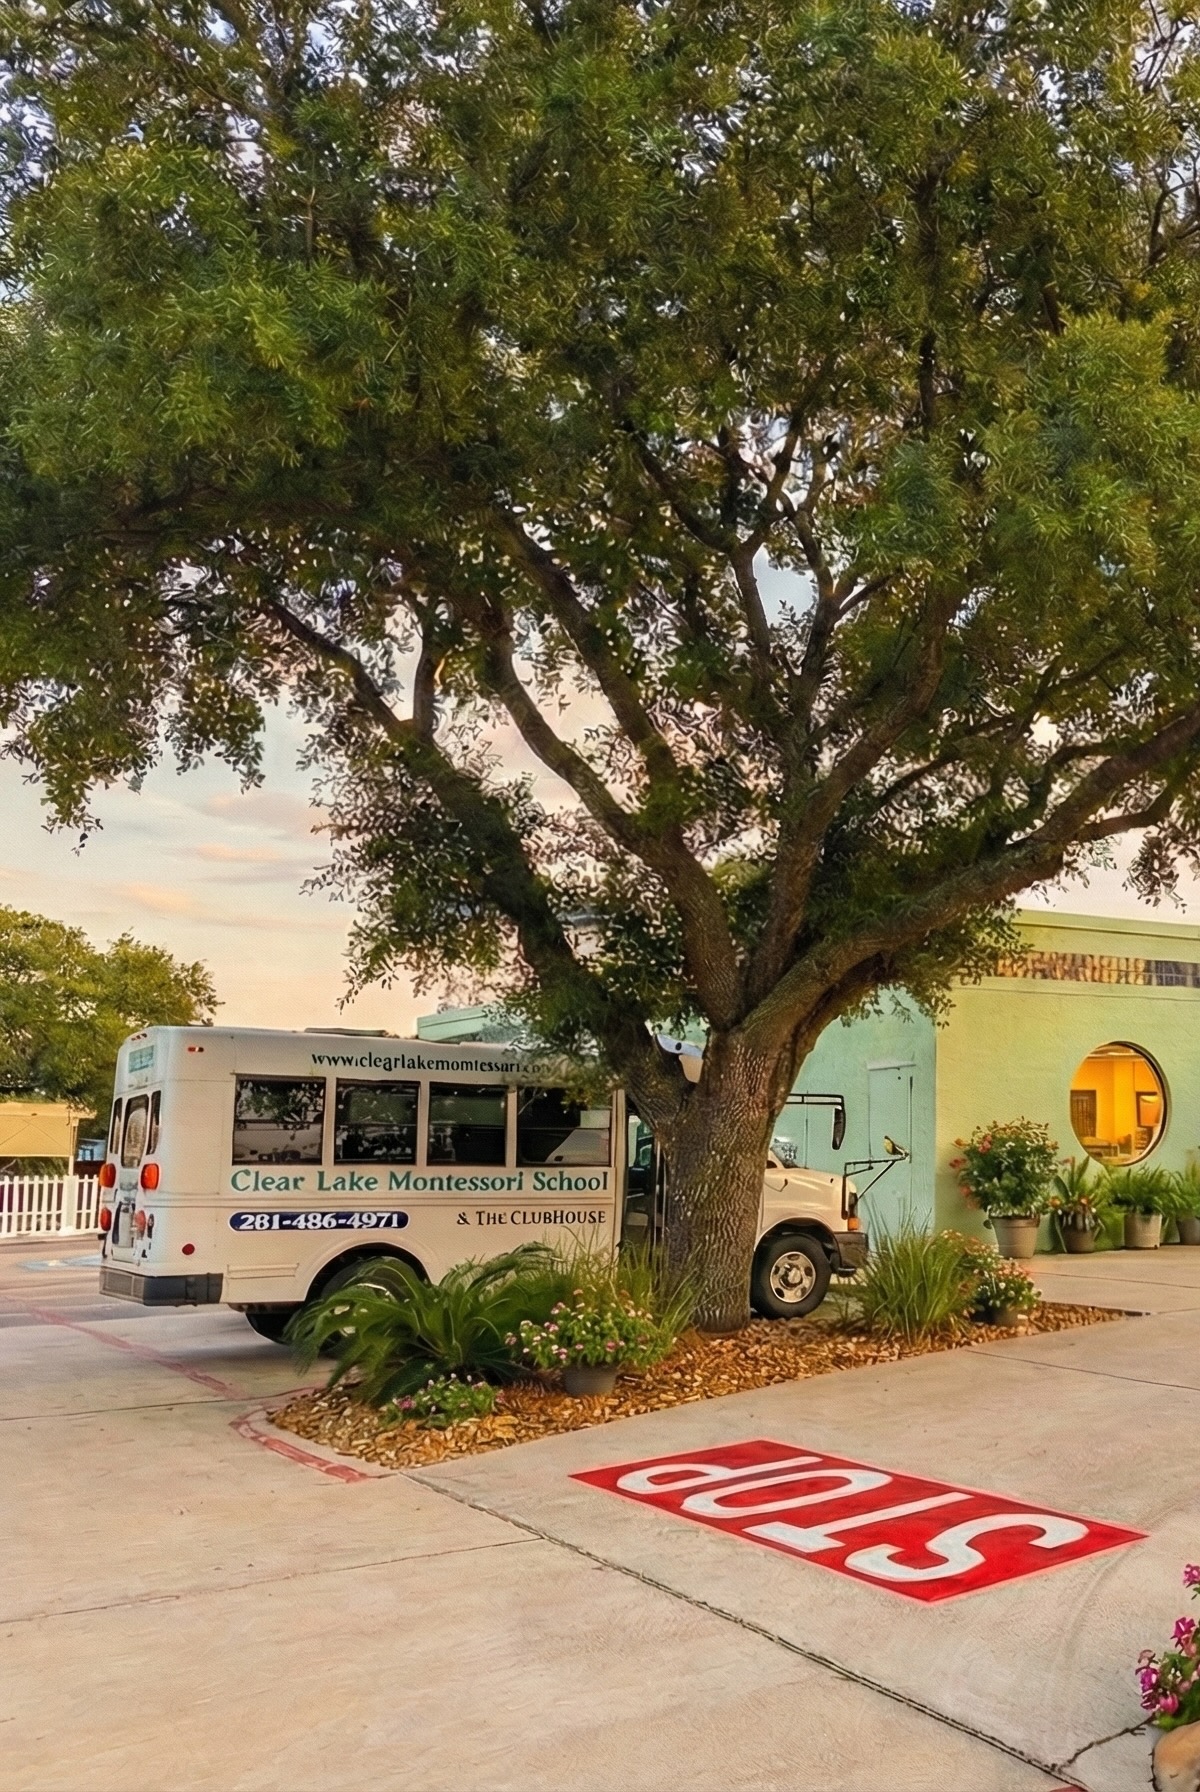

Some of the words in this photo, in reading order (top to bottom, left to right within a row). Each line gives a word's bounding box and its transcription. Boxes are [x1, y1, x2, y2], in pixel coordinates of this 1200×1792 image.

[231, 1169, 305, 1192] Clear
[317, 1170, 378, 1191] Lake
[388, 1170, 524, 1192] Montessori
[532, 1171, 608, 1191] School
[239, 1212, 399, 1230] 281-486-4971
[457, 1212, 470, 1225] &
[615, 1456, 1090, 1582] STOP
